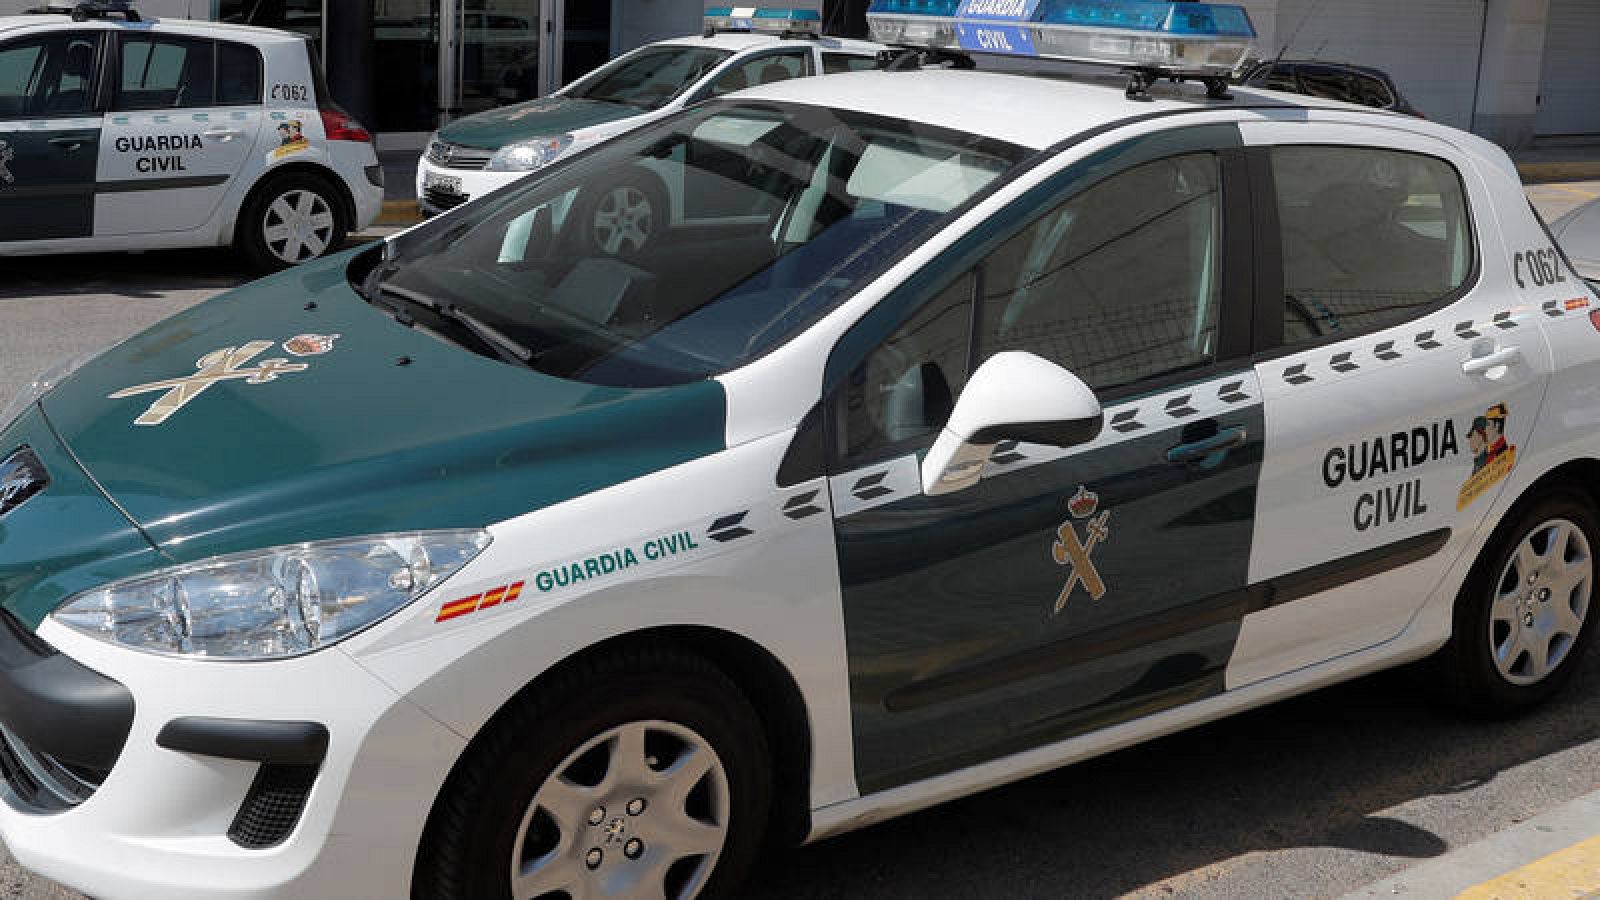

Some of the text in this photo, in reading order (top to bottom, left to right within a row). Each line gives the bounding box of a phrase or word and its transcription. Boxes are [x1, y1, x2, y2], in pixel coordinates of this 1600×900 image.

[977, 29, 1013, 50] CIVIL
[115, 134, 203, 152] GUARDIA
[136, 156, 186, 172] CIVIL
[1525, 248, 1566, 286] 062
[1322, 419, 1459, 488] GUARDIA
[1353, 478, 1427, 531] CIVIL
[535, 530, 699, 592] GUARDIA CIVIL
